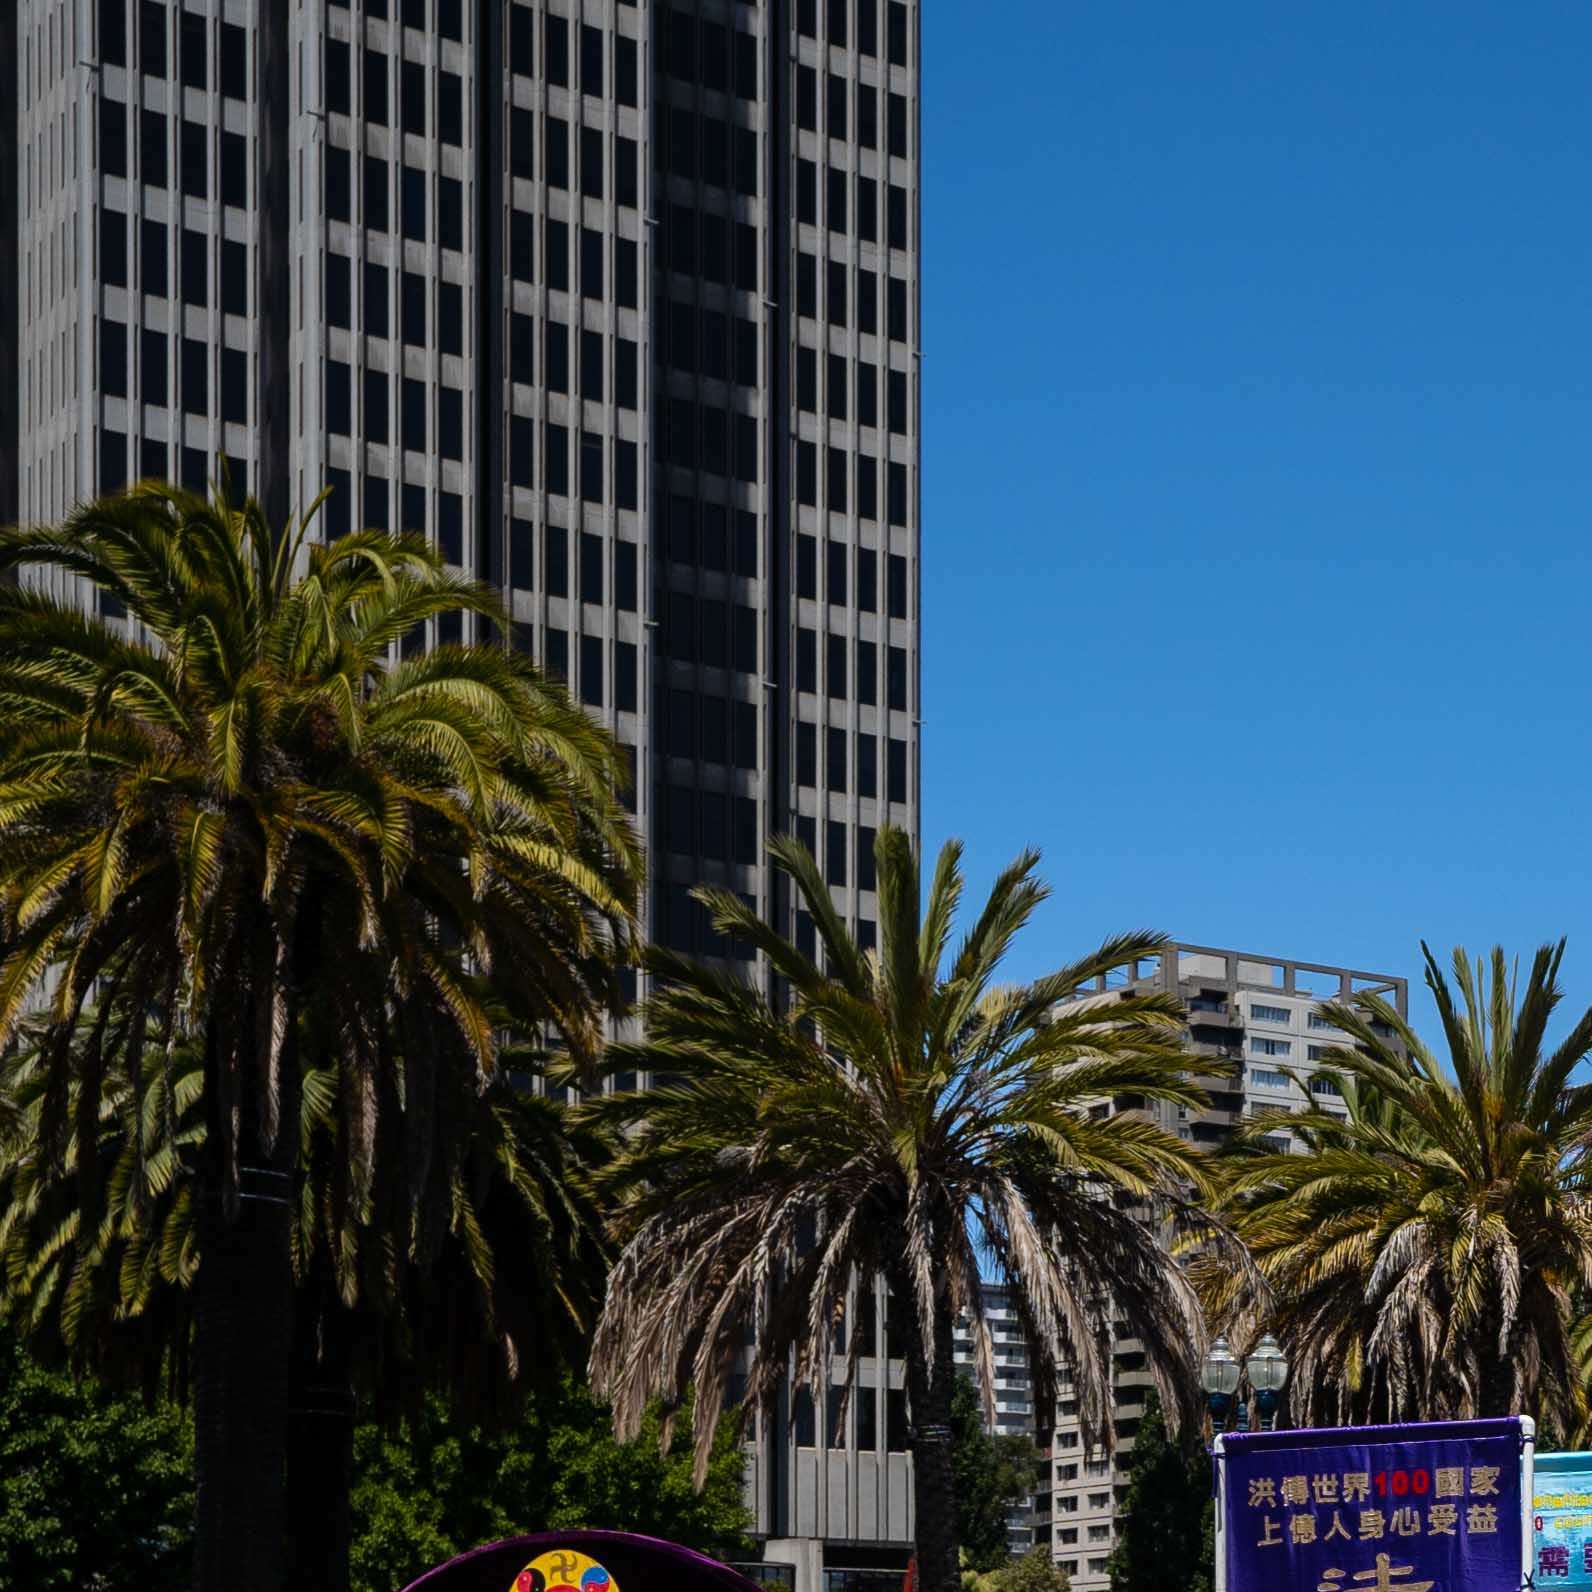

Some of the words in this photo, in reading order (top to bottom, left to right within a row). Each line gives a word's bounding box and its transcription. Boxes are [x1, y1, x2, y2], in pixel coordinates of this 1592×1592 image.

[1257, 1503, 1498, 1547] 上億人身心受益
[1534, 1515, 1543, 1531] 0
